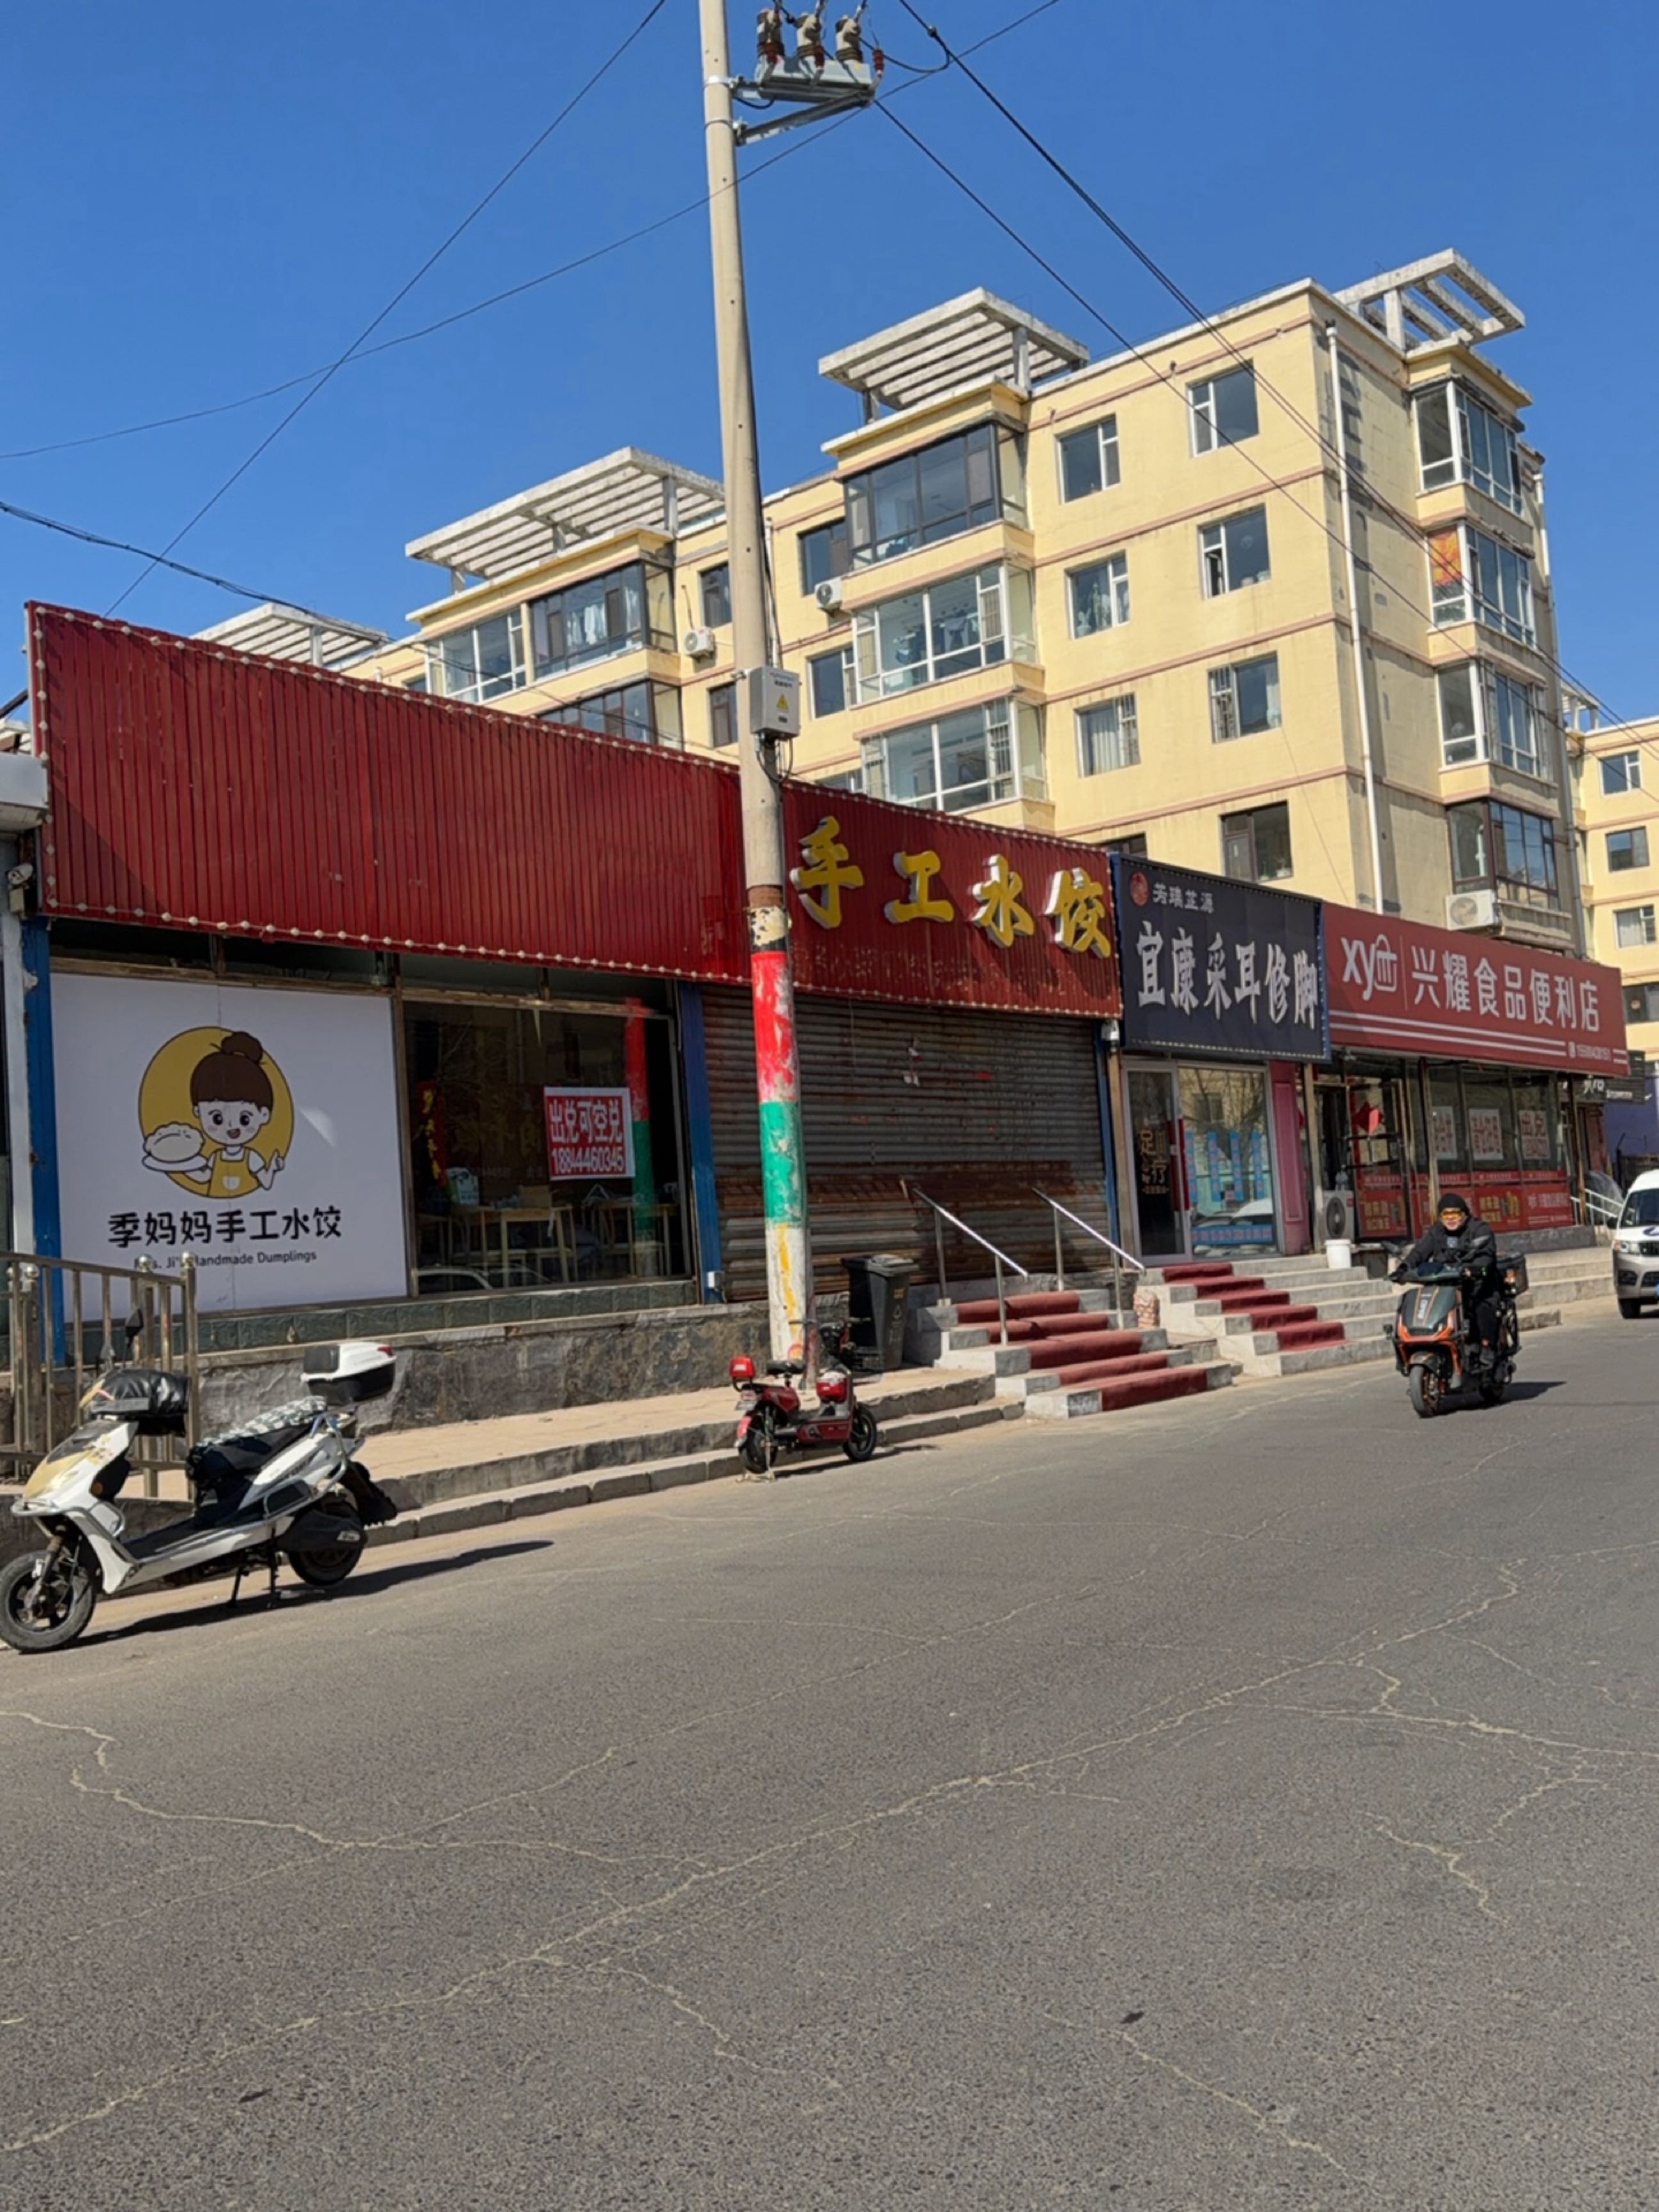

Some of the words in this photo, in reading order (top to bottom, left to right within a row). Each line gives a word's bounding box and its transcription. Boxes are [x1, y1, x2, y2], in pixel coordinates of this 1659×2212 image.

[790, 815, 1112, 958] 手工水饺
[1137, 920, 1318, 1030] 宜康采耳修脚
[1411, 945, 1599, 1032] 兴耀食品便利店
[549, 1099, 623, 1144] 出兑可空兑
[108, 1205, 342, 1248] 季妈妈手工水饺
[257, 1249, 317, 1264] Dumplings
